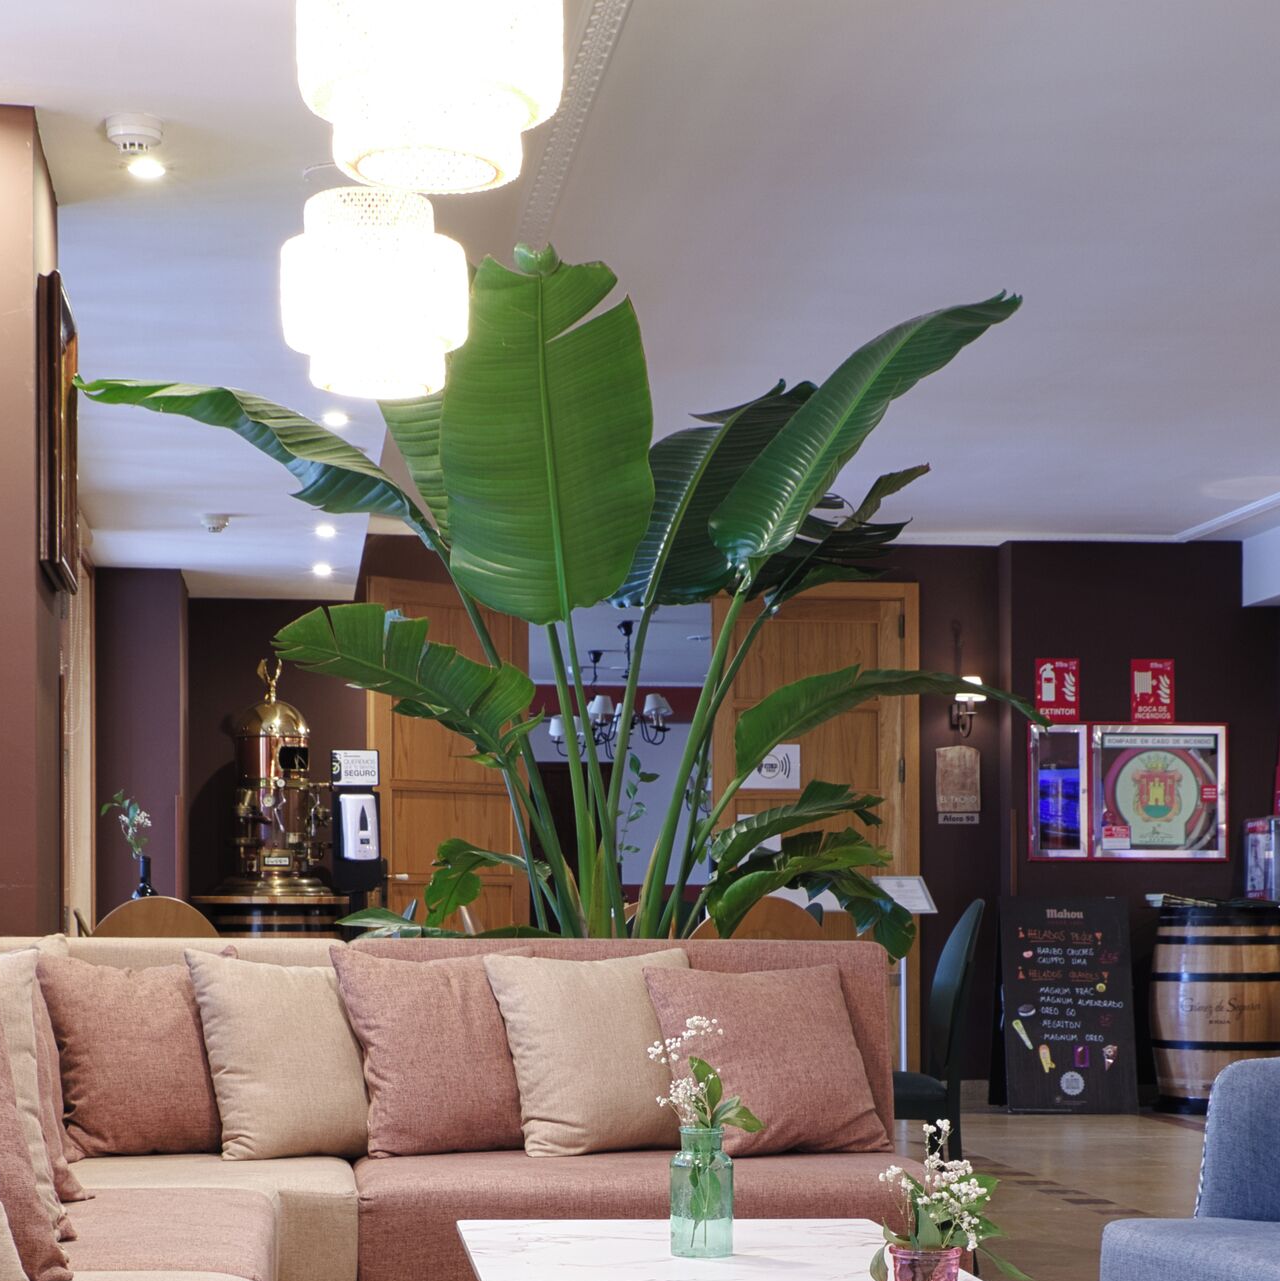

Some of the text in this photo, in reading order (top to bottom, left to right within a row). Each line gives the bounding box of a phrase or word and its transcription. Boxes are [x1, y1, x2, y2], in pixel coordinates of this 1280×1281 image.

[1039, 708, 1076, 716] EXTINTOR
[1135, 712, 1171, 720] INCENDIOS
[344, 769, 377, 777] SEGURO
[1045, 908, 1084, 919] Mahou
[1027, 929, 1066, 941] HELADOS
[1036, 947, 1063, 956] HARIBO
[1039, 986, 1072, 995] MAGNUM
[1039, 996, 1124, 1009] MAGNUM ALMENDRADO
[1040, 1007, 1059, 1015] OREO
[1043, 1033, 1105, 1042] MAGNUM OREO
